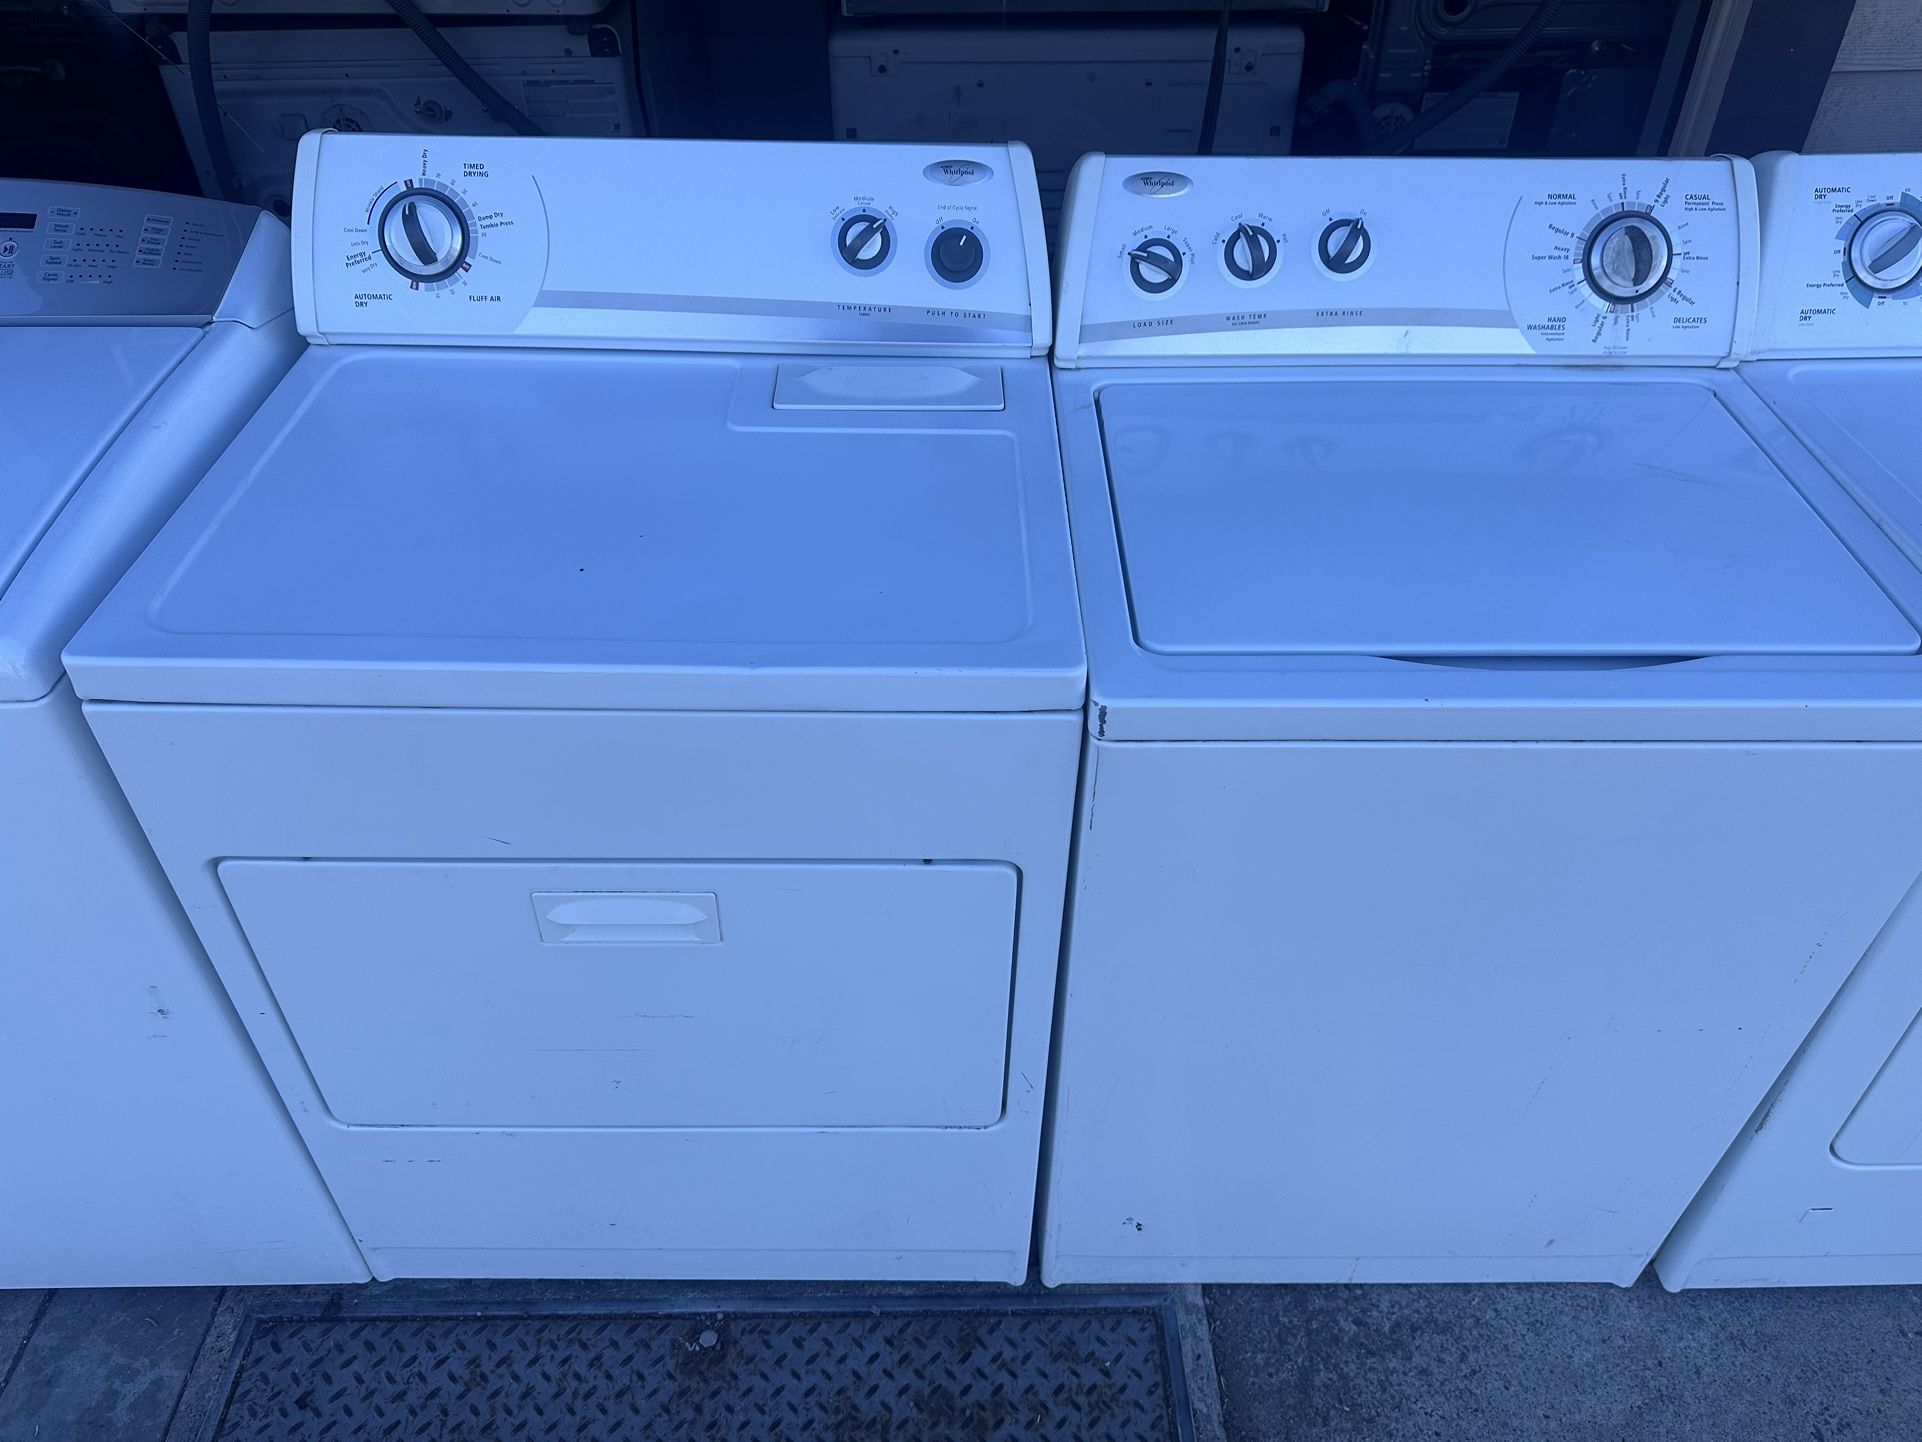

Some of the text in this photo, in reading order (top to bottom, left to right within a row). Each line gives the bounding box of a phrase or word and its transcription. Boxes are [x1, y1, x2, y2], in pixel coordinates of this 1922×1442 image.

[421, 149, 429, 176] Heavy Dry
[463, 170, 489, 178] DRYING
[943, 168, 975, 177] Whirlpool
[1143, 179, 1175, 188] Whirlpool
[1655, 177, 1670, 199] Regular
[1684, 193, 1711, 201] CASUAL
[830, 206, 840, 216] Low
[887, 205, 899, 217] High
[1321, 208, 1331, 217] Off
[1359, 208, 1368, 216] On
[477, 211, 504, 223] Damp Dry
[935, 216, 944, 225] Off
[972, 217, 980, 225] On
[1230, 212, 1243, 222] Cool
[1258, 213, 1273, 222] Warm
[480, 220, 514, 231] Tumble Press
[1163, 225, 1179, 235] Large
[1548, 223, 1570, 237] Regular
[1132, 225, 1153, 237] Medium
[1211, 232, 1221, 245] Cold
[1281, 233, 1289, 243] Hot
[1182, 237, 1193, 253] Super
[1553, 245, 1570, 254] Heavy
[1117, 243, 1127, 259] Small
[345, 251, 366, 262] Energy
[345, 255, 373, 268] Preferred
[354, 293, 393, 301] AUTOMATIC
[1676, 289, 1696, 306] Regular
[837, 303, 892, 314] TEMPERATURE
[1316, 309, 1363, 318] EXTRA RINSE
[926, 309, 946, 317] PUSH
[963, 312, 987, 320] START
[1225, 314, 1246, 322] WASH
[1132, 319, 1175, 329] LOAD SIZE
[1591, 313, 1602, 328] Light
[1526, 323, 1566, 331] WASHABLES
[1591, 320, 1605, 343] Regular
